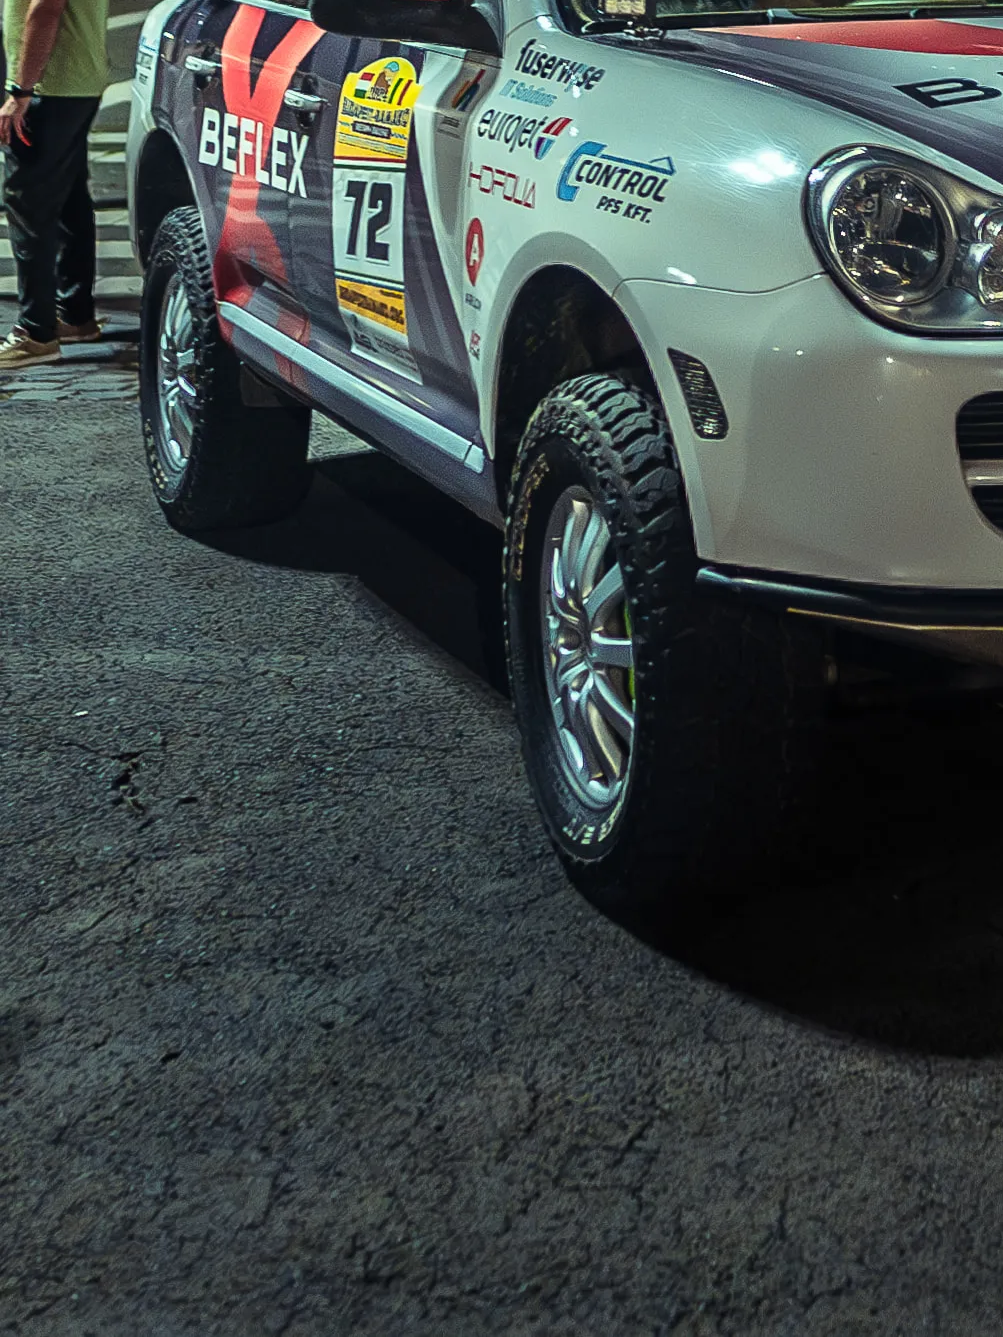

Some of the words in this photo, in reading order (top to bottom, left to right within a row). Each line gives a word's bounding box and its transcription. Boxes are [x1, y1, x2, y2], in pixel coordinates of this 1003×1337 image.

[199, 107, 309, 198] BEFLEX
[477, 109, 548, 153] eurojet
[575, 159, 668, 203] CONTROL
[344, 180, 392, 264] 72
[596, 196, 623, 214] PFS
[622, 203, 652, 223] KFT.
